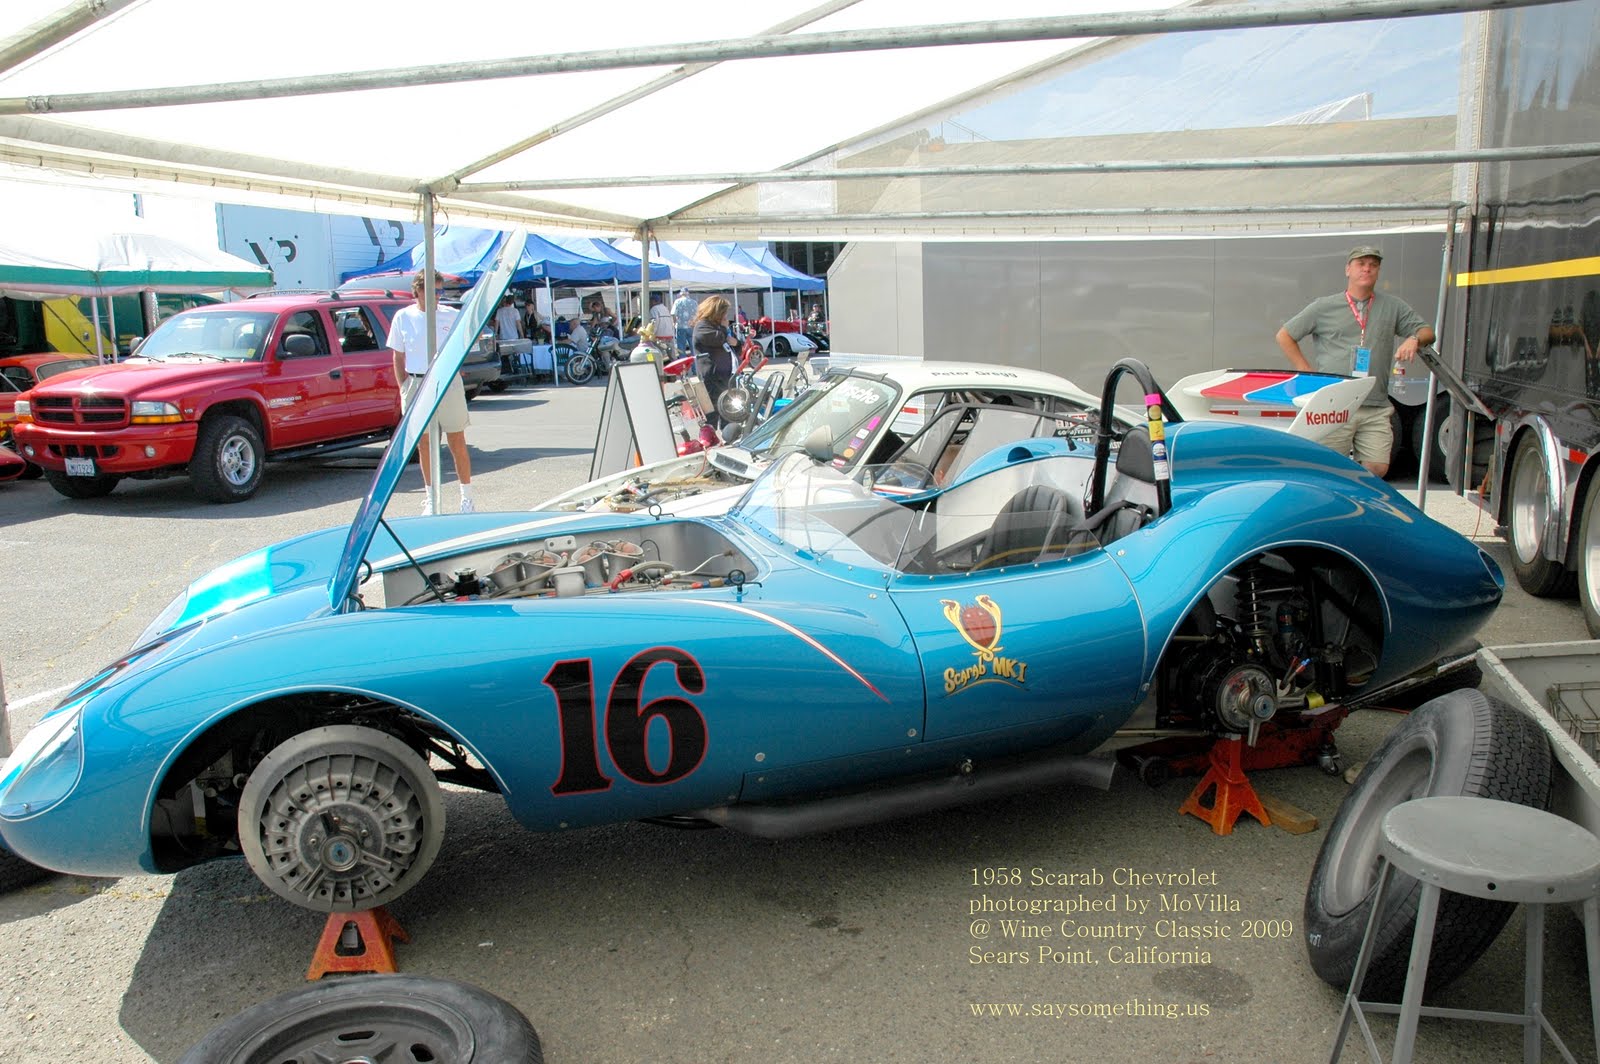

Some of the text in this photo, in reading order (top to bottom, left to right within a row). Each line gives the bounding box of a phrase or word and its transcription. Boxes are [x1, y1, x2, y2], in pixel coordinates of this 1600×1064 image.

[975, 370, 1018, 379] Gregg
[838, 380, 880, 405] rsche
[1305, 409, 1349, 426] Kendall
[943, 656, 987, 694] Scarab
[541, 645, 709, 797] 16
